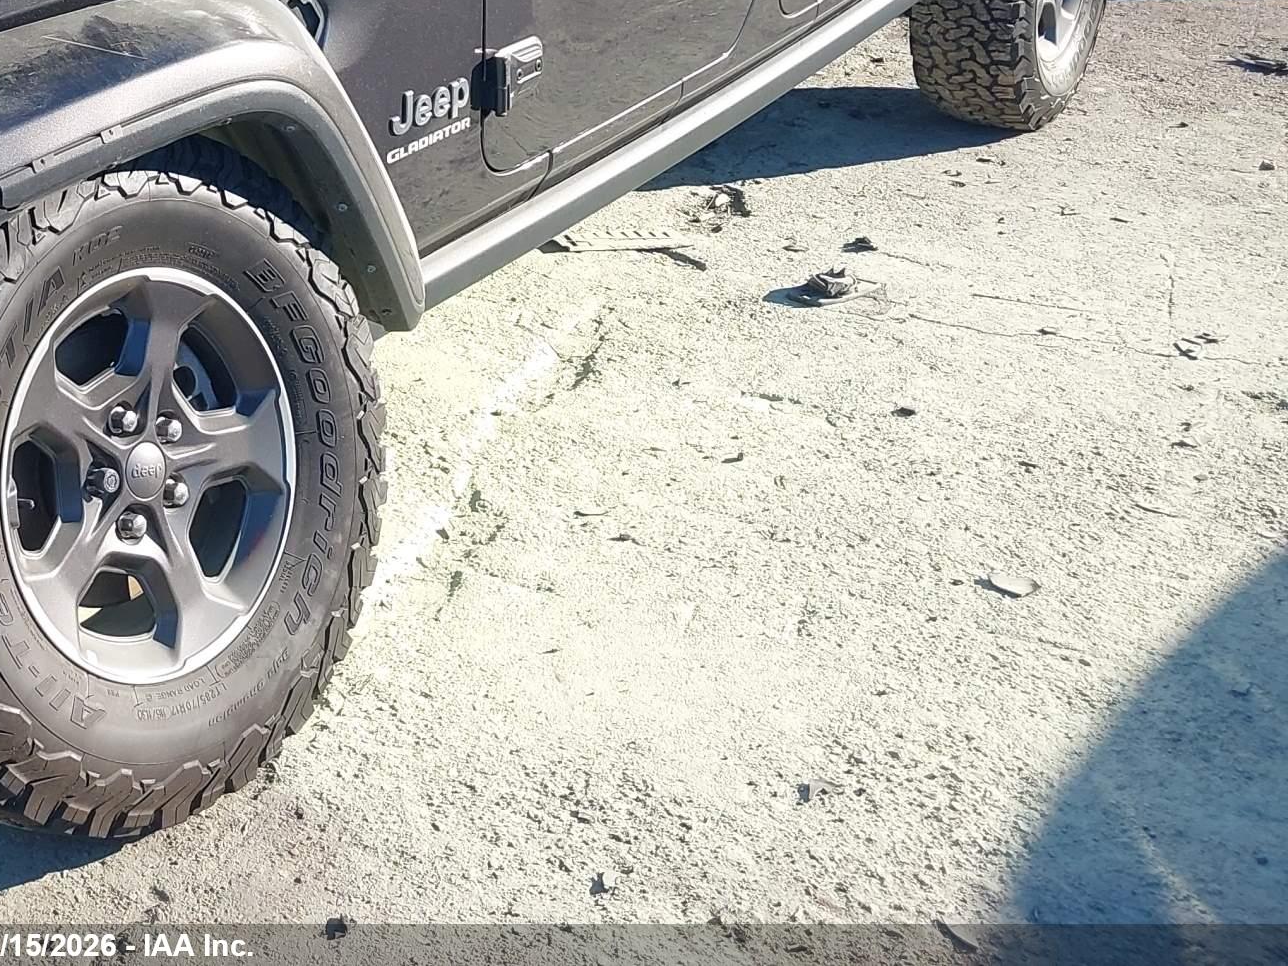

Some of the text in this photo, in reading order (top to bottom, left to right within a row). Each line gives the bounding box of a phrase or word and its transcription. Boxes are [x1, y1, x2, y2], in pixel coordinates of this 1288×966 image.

[388, 77, 470, 136] Jeep
[386, 116, 471, 164] GLADIATOR
[242, 258, 344, 636] BFGoodrich
